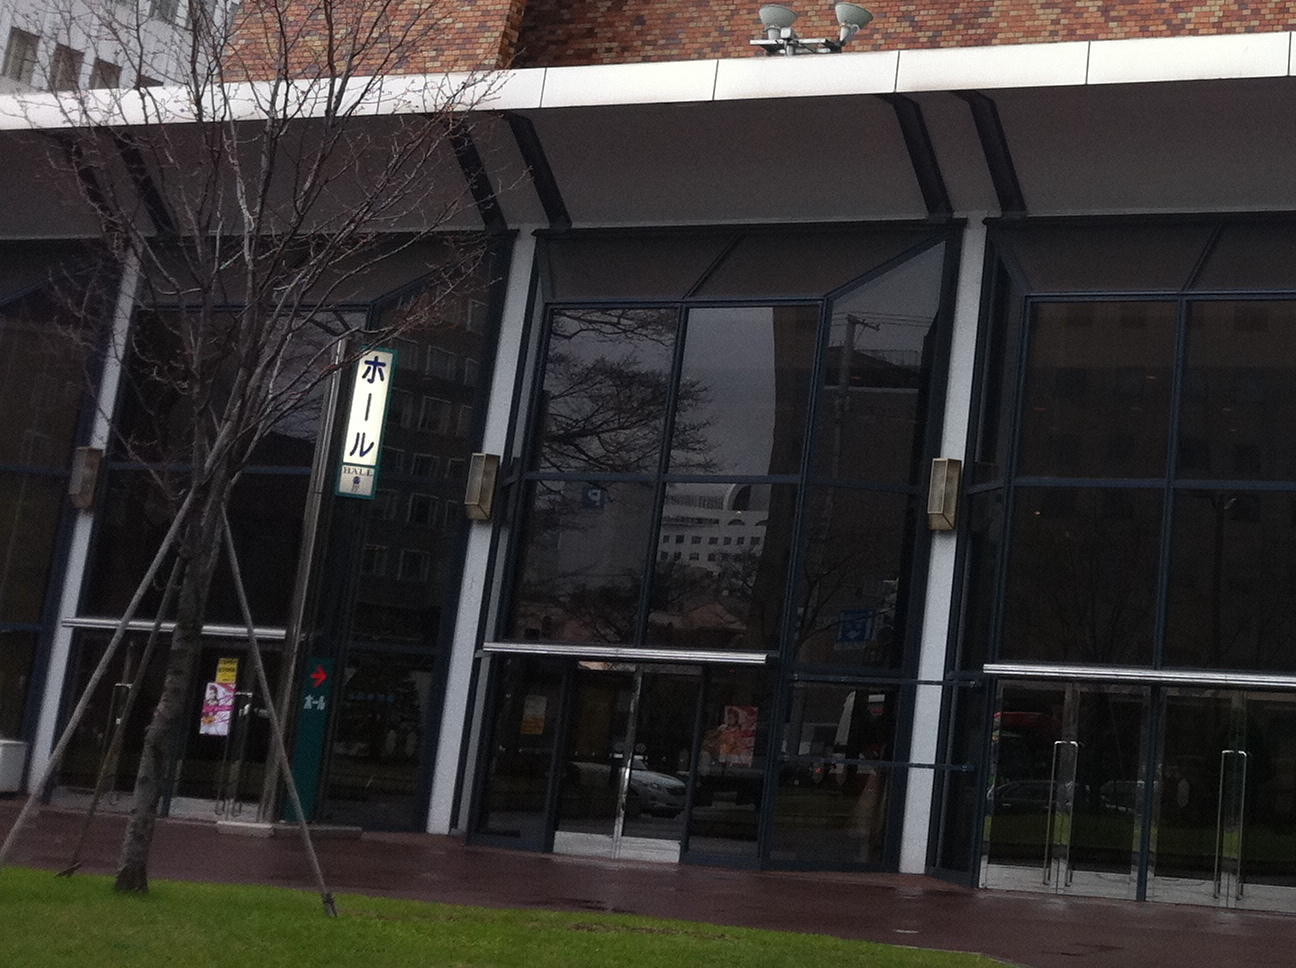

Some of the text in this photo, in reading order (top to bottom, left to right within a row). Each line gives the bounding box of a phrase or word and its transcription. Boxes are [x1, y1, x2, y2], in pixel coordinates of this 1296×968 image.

[349, 355, 387, 458] ホール
[343, 466, 374, 476] HALL
